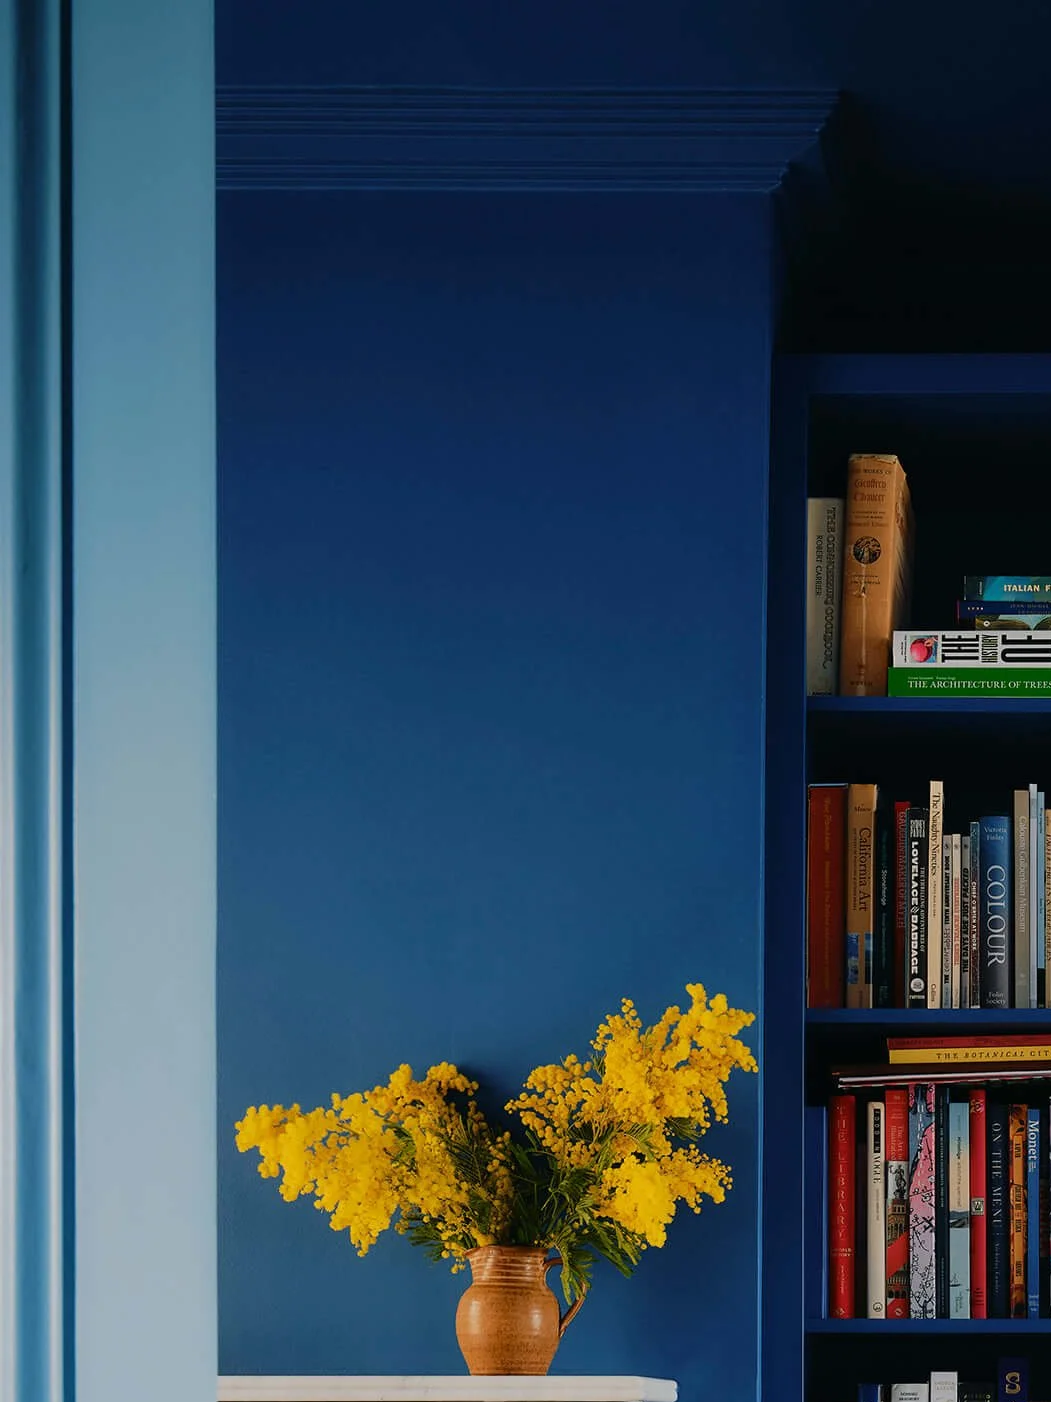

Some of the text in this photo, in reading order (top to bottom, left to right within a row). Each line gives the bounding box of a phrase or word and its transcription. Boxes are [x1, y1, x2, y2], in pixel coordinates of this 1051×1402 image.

[942, 635, 979, 663] THE
[981, 634, 998, 663] HISTORY
[908, 680, 928, 689] THE
[930, 680, 1004, 689] ARCHITECTURE
[1005, 680, 1020, 689] OF
[858, 828, 871, 912] California Art
[986, 865, 1004, 967] COLOUR
[1028, 1120, 1039, 1161] Monet
[991, 1122, 1002, 1228] ON THE MENU
